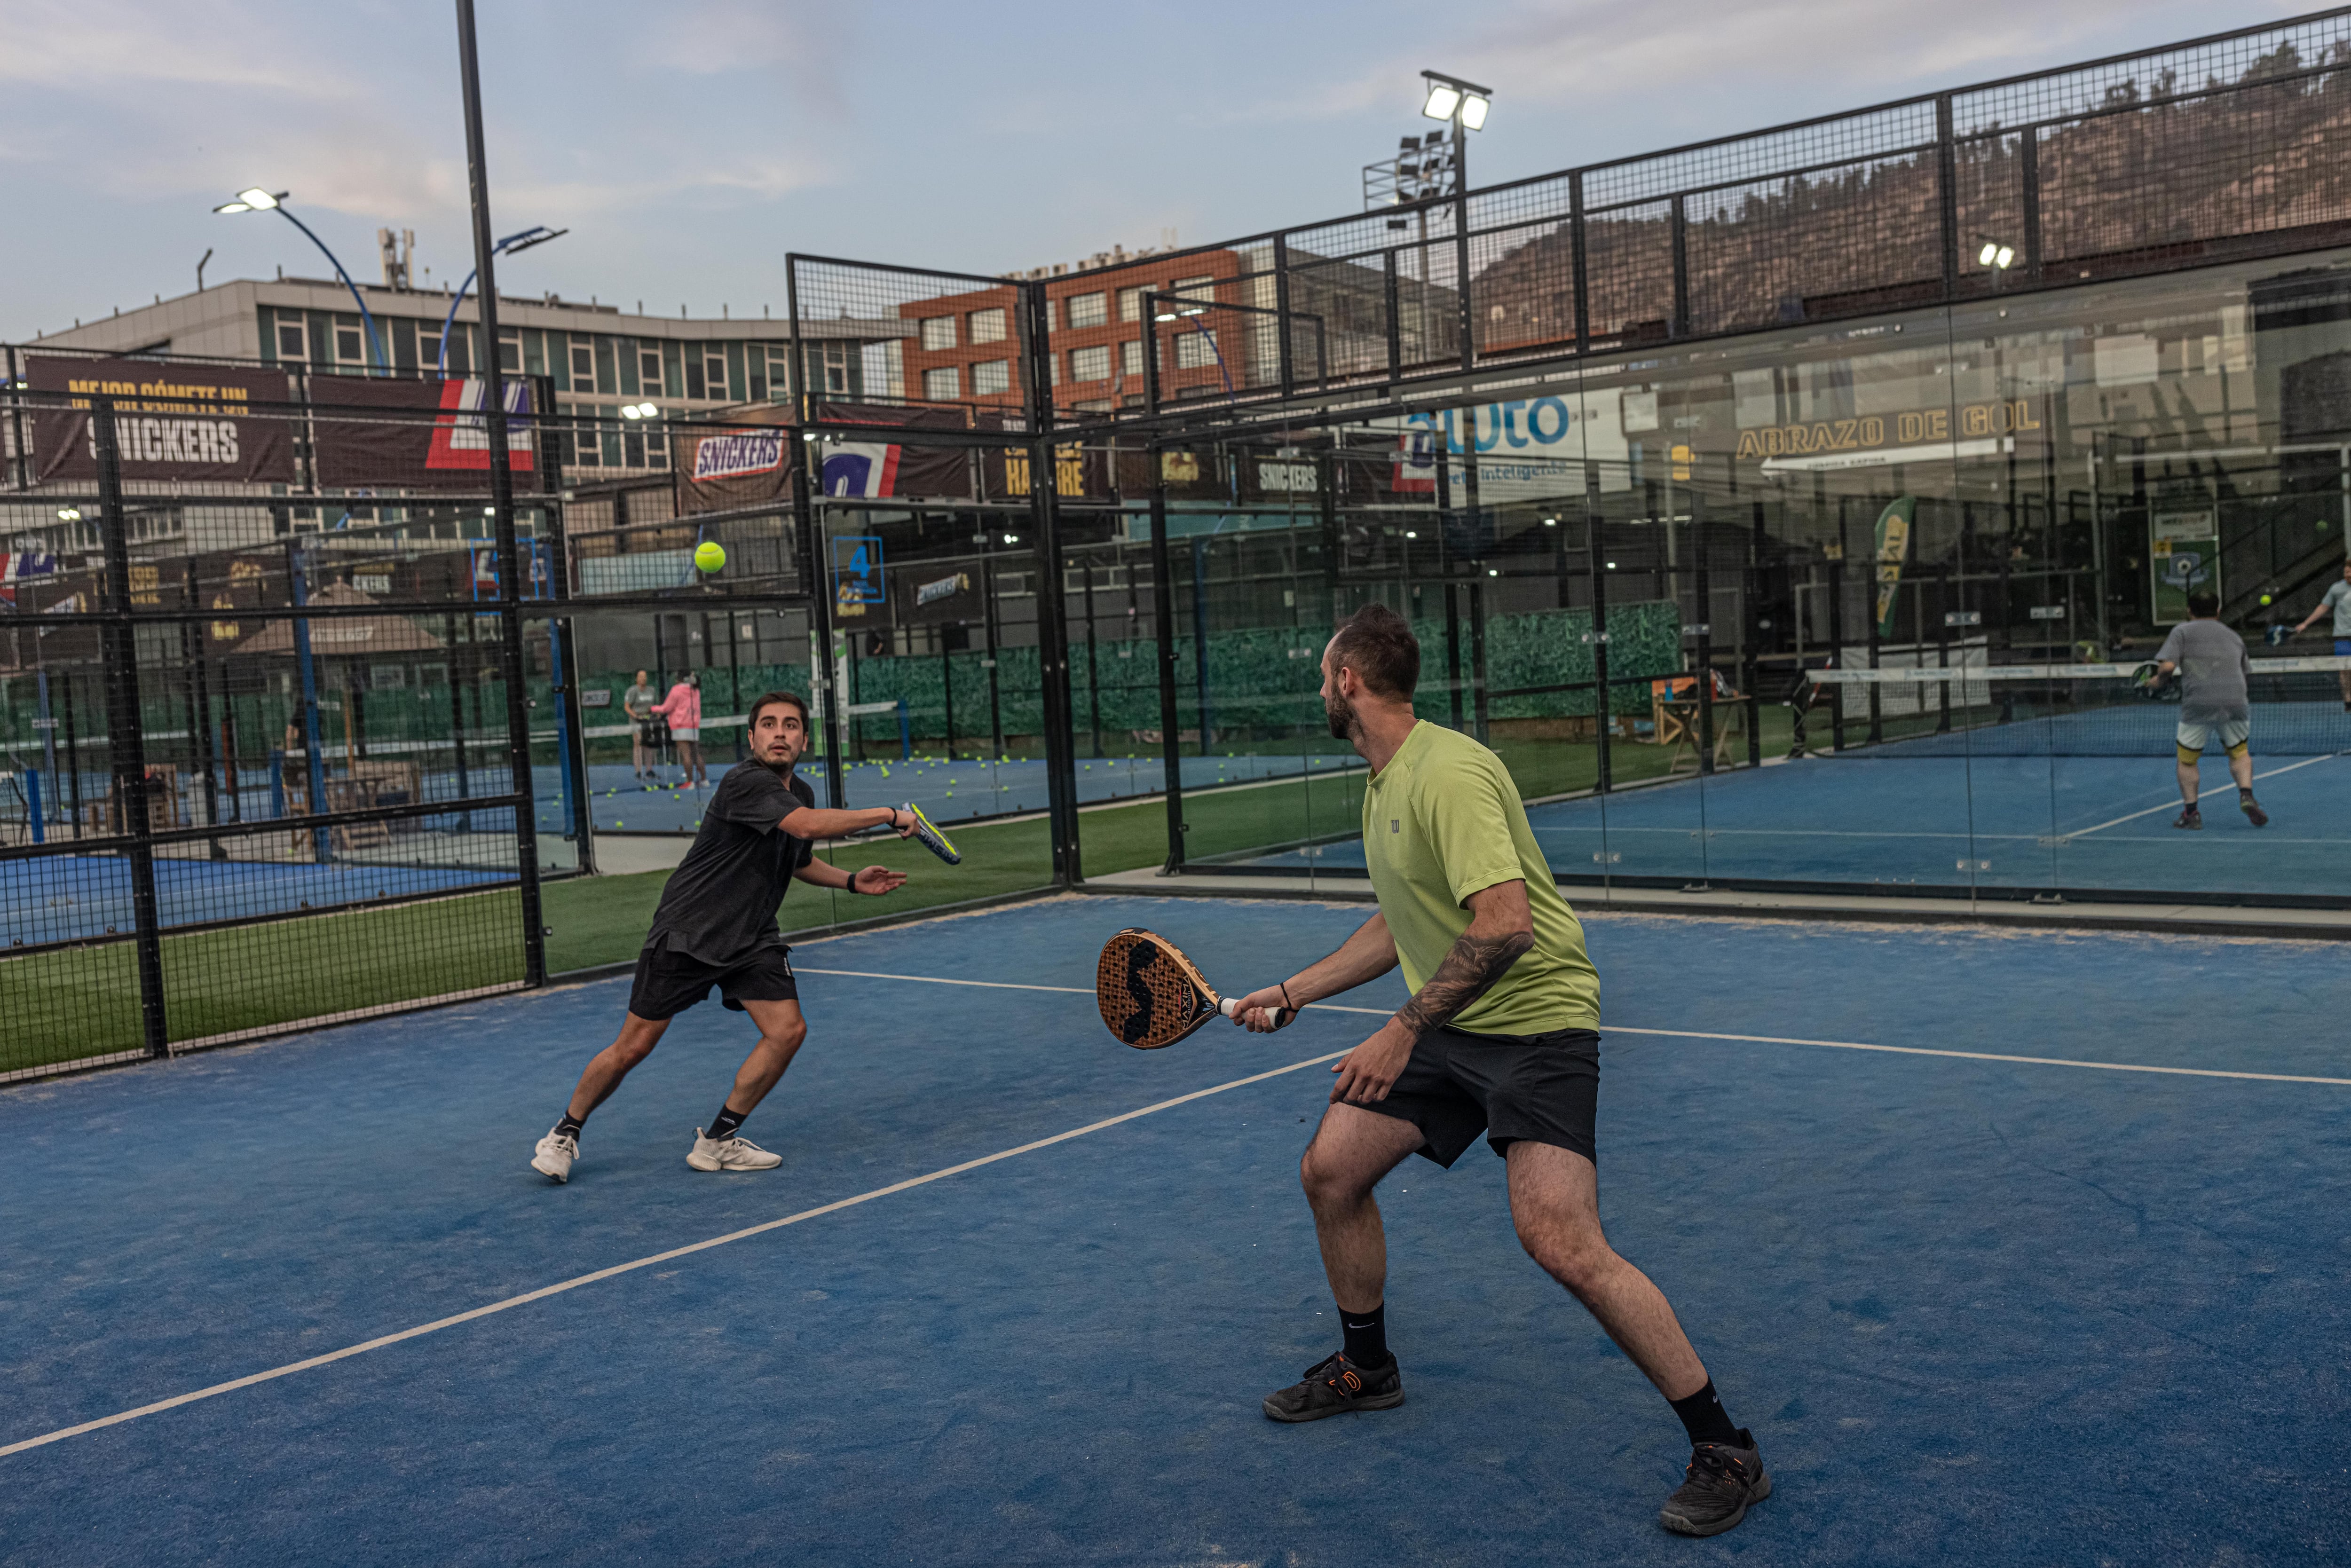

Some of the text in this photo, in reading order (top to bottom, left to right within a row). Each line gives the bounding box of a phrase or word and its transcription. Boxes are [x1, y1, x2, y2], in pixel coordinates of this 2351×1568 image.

[1736, 400, 2040, 460] ABRAZO DE GOL
[699, 428, 781, 475] SNICKERS
[1259, 463, 1317, 492] SNICKERS
[849, 545, 870, 579] 4
